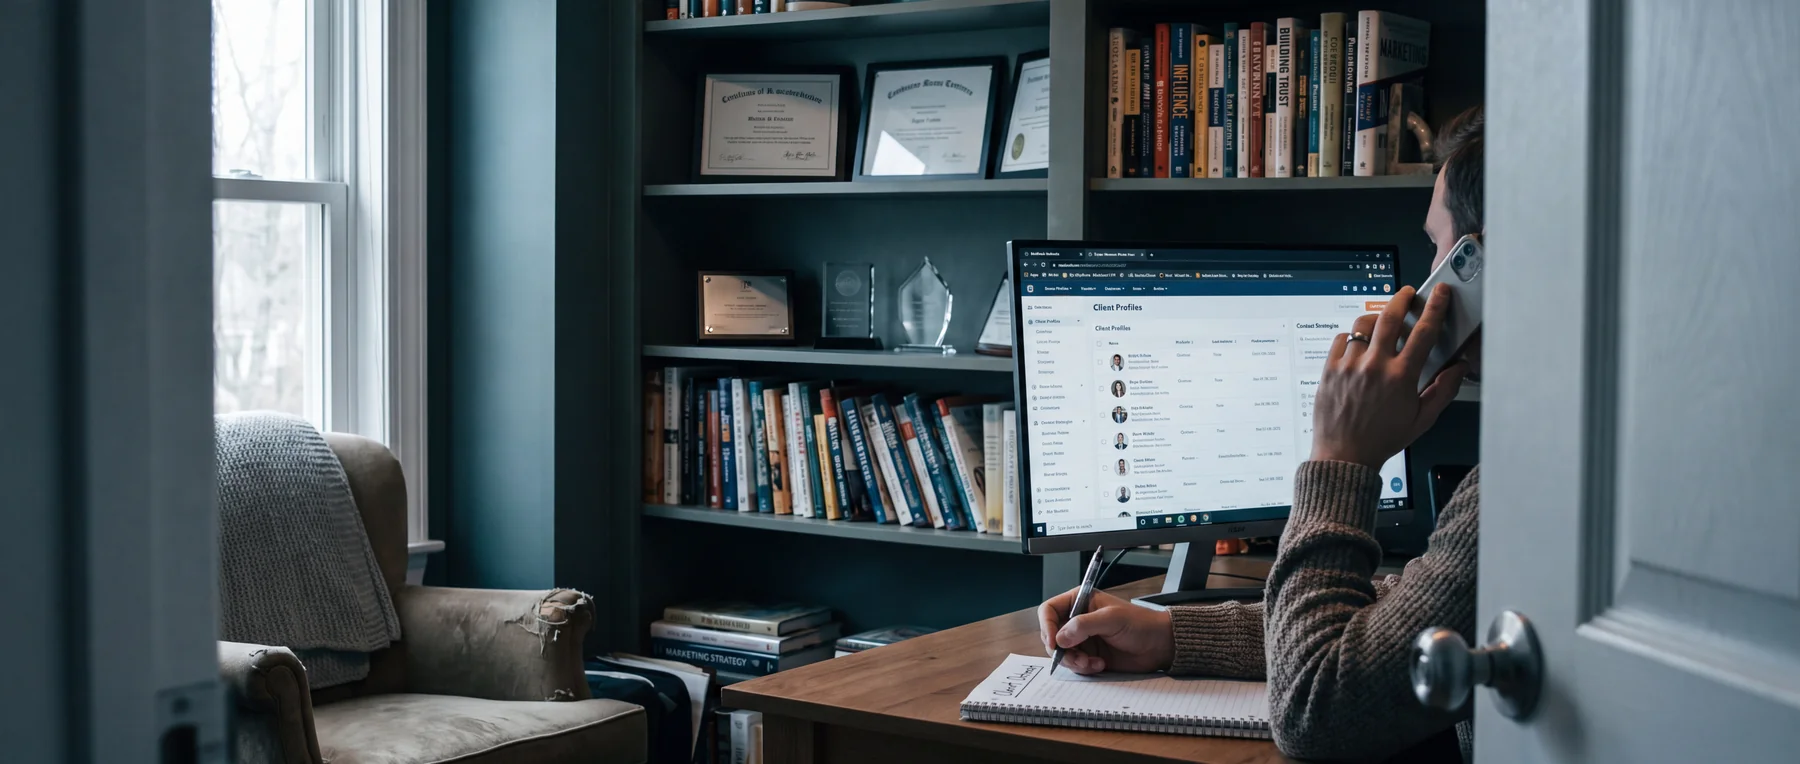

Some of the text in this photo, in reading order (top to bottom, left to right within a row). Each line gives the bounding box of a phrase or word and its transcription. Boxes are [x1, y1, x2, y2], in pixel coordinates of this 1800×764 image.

[1380, 37, 1427, 66] MARKETING
[1278, 27, 1291, 107] BUILDING TRUST
[1172, 64, 1189, 119] INFLUENCE
[1093, 303, 1143, 312] Client Profiles
[665, 647, 748, 667] MARKETING STRATEGY
